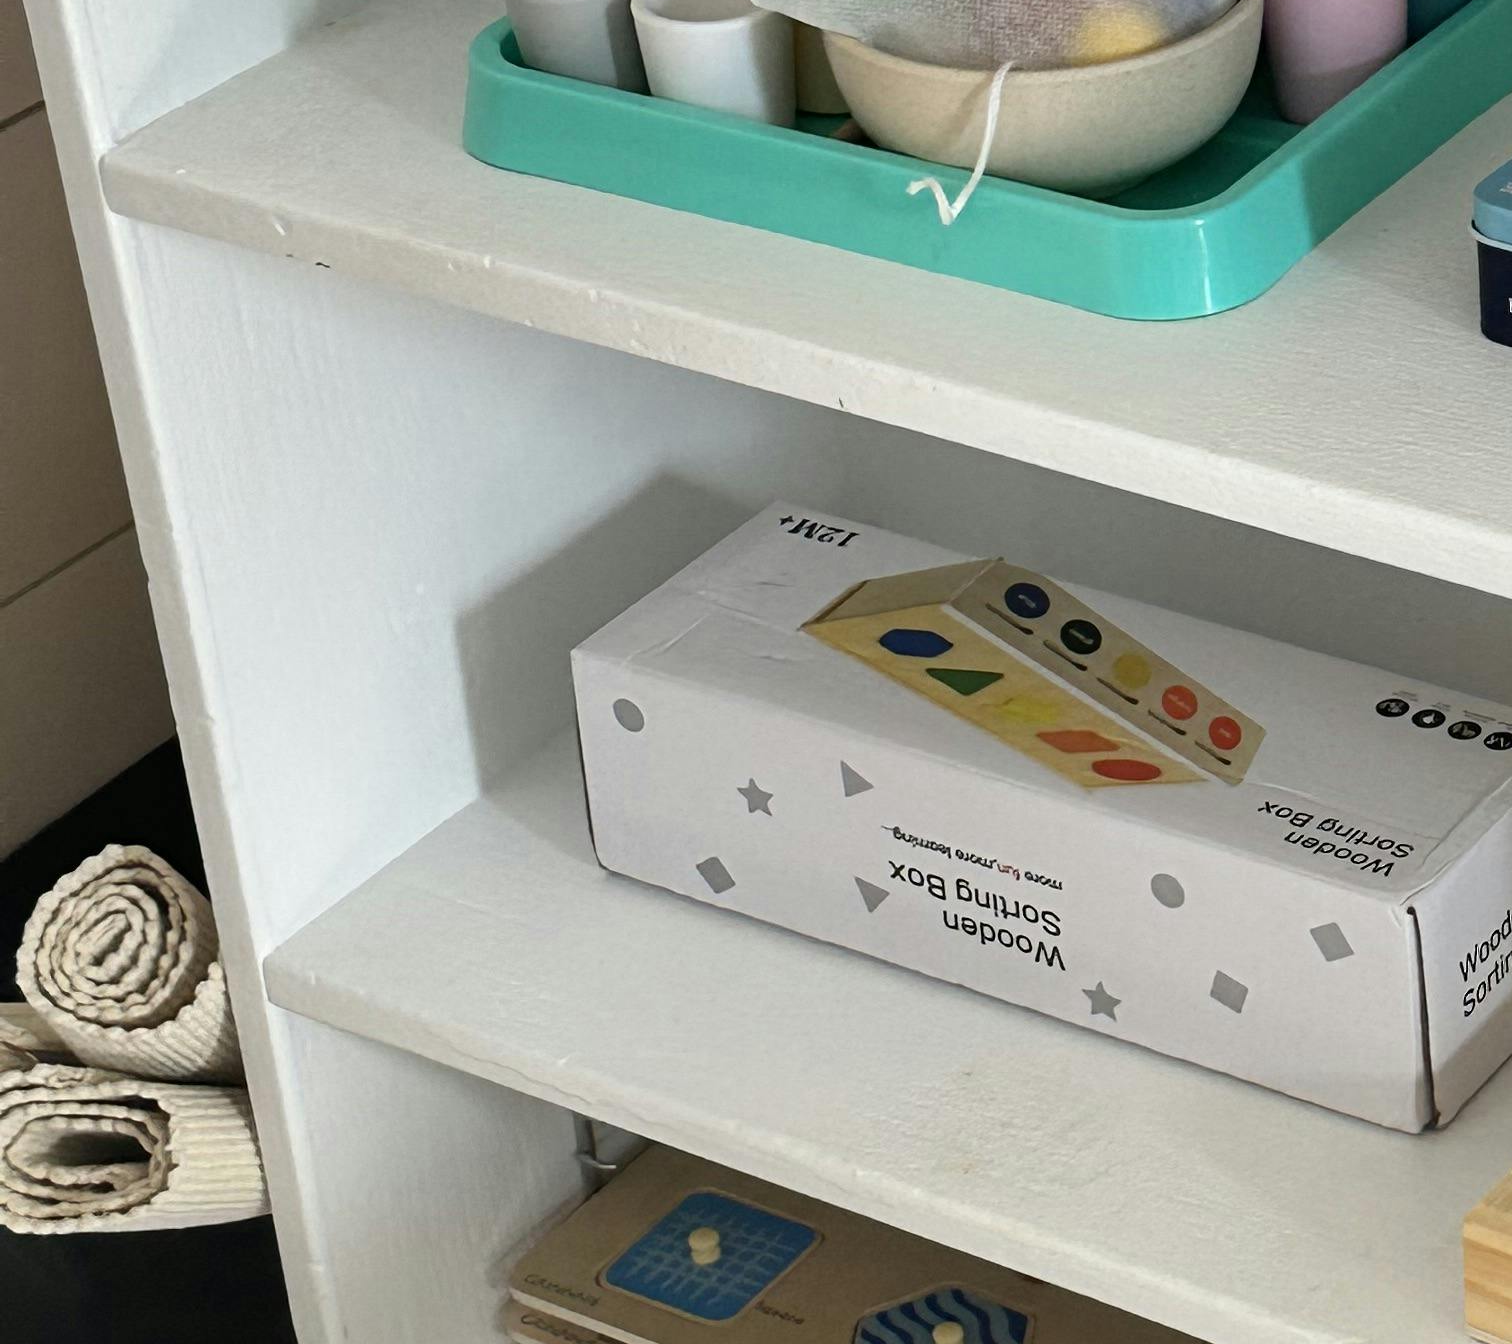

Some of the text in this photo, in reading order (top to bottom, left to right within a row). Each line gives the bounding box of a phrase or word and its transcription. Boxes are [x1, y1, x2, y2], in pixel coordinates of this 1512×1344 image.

[779, 515, 860, 547] 12M+
[881, 825, 952, 859] learning
[1257, 801, 1415, 858] Sorting Box
[1283, 831, 1395, 877] Wooden
[888, 860, 1061, 937] Sorting Box
[1024, 870, 1063, 891] more
[942, 909, 1067, 971] Wooden
